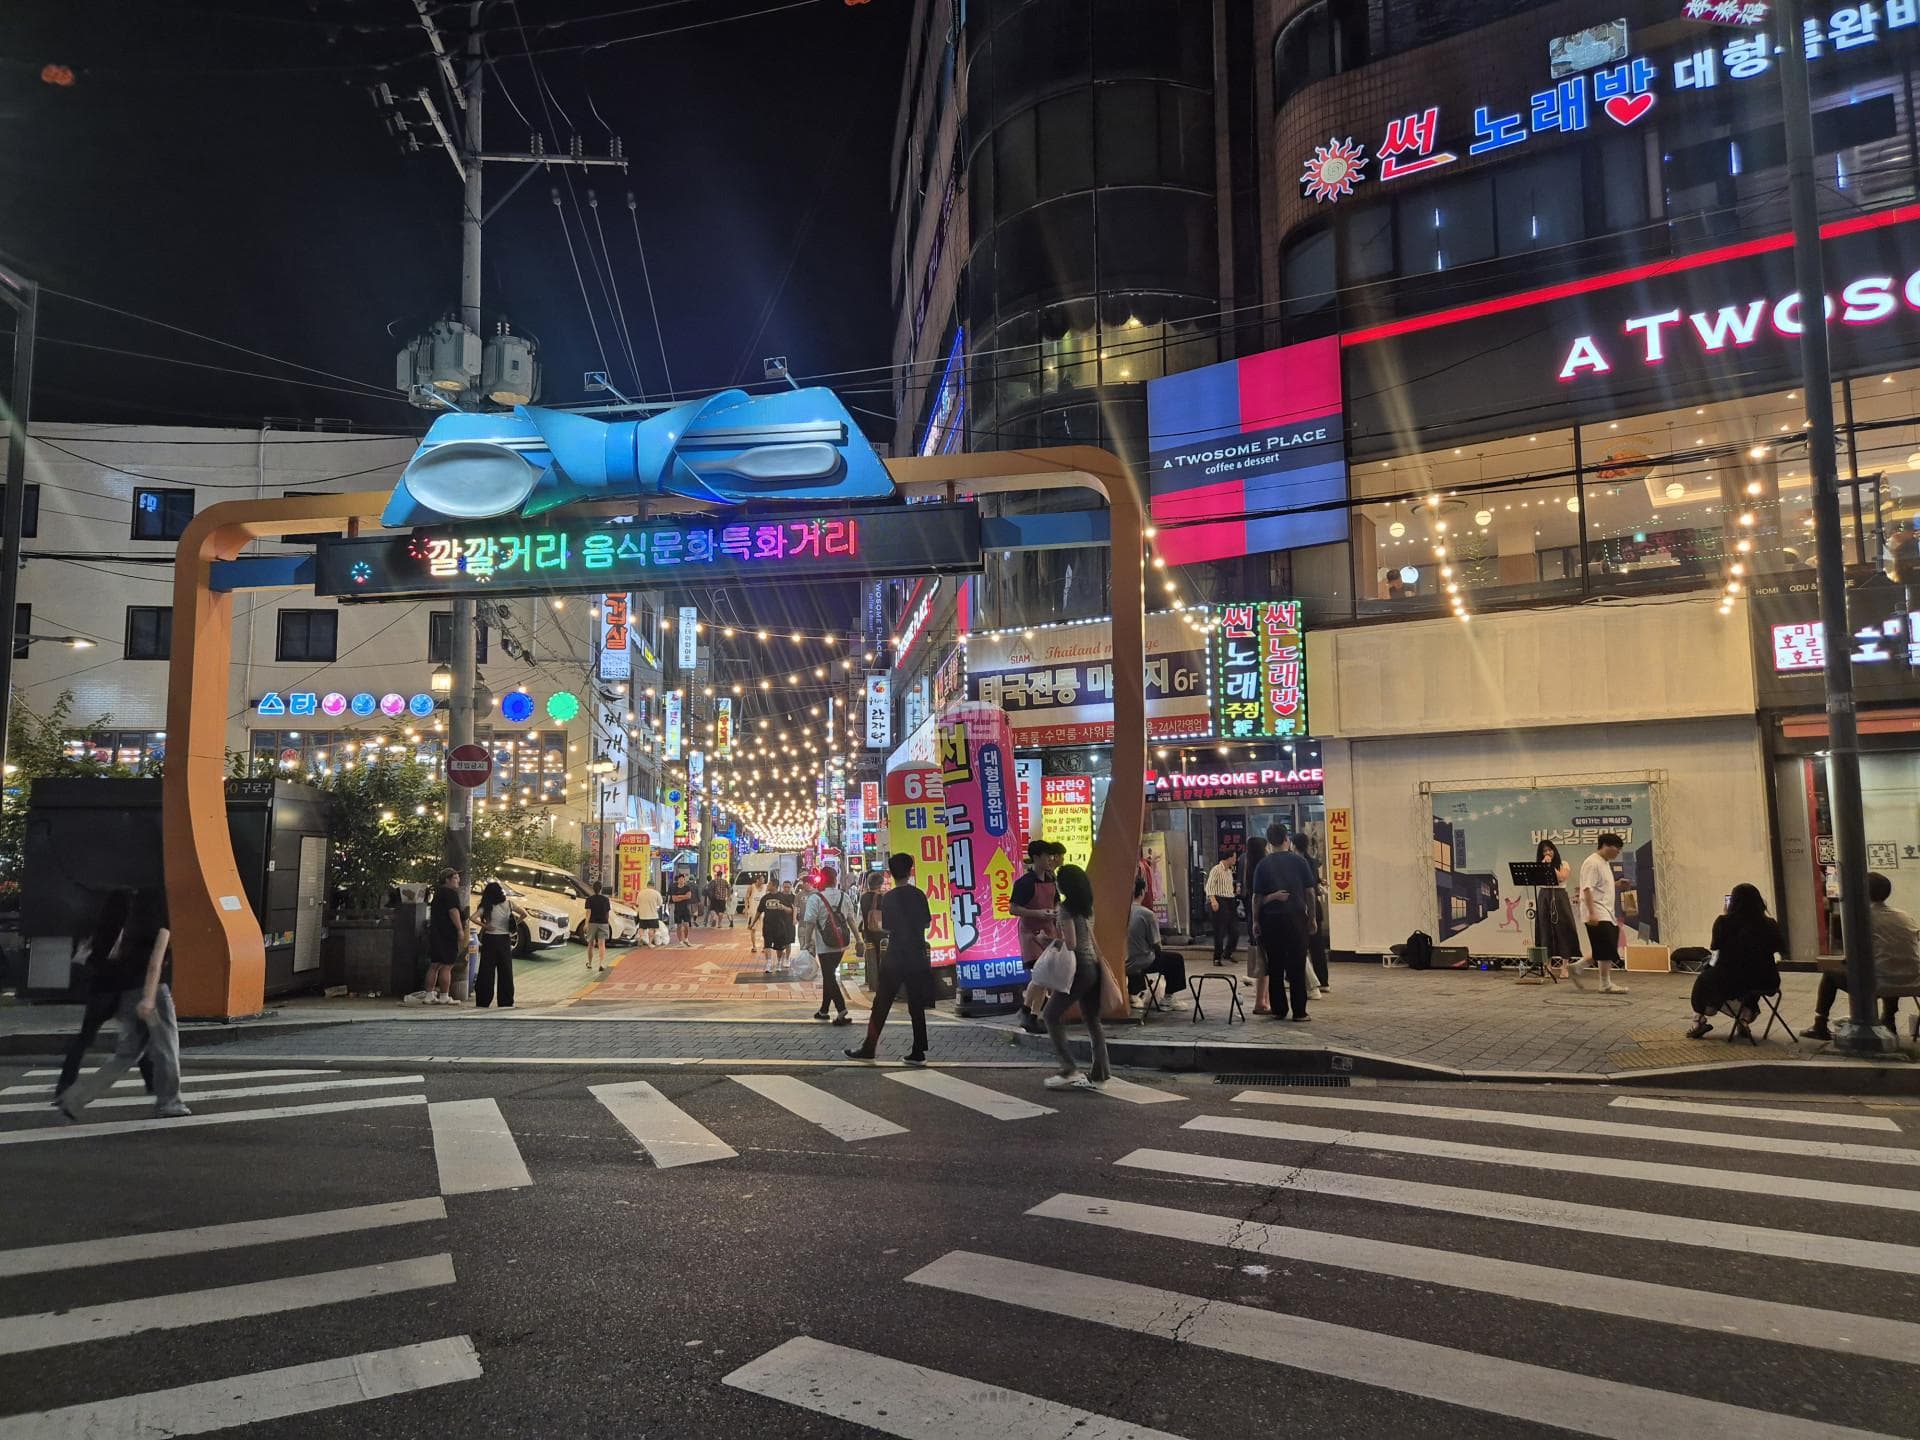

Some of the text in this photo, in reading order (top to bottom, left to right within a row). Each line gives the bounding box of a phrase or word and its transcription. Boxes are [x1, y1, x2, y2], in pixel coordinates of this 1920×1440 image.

[1376, 107, 1458, 182] 썬
[1559, 335, 1611, 379] A
[1163, 429, 1327, 469] A TWOSOME PLACE
[1205, 462, 1235, 475] coffee
[1244, 453, 1280, 468] dessert
[428, 519, 857, 576] 깔깔거리 음식문화특화거리
[1756, 586, 1779, 595] HOMI
[1789, 584, 1809, 592] ODU
[605, 592, 628, 650] 겹살
[1010, 654, 1031, 665] SIAM
[1045, 644, 1101, 660] Thailand
[978, 667, 1080, 707] 태국전통
[1087, 658, 1169, 698] 마지
[1174, 668, 1199, 691] 6F
[258, 692, 318, 716] 스타
[1225, 702, 1259, 719] 주점
[602, 711, 623, 803] 찌개가
[241, 783, 272, 794] 구로구
[904, 772, 943, 800] 6층
[983, 750, 1004, 830] 대형룸완비
[1045, 780, 1087, 792] 장군한우
[1156, 768, 1323, 788] A TWOSOME PLACE
[1330, 811, 1353, 889] 썬노래방
[920, 835, 950, 941] 마사지
[1335, 892, 1351, 900] 3F
[963, 964, 981, 980] 매일
[983, 960, 1025, 978] 업데이트
